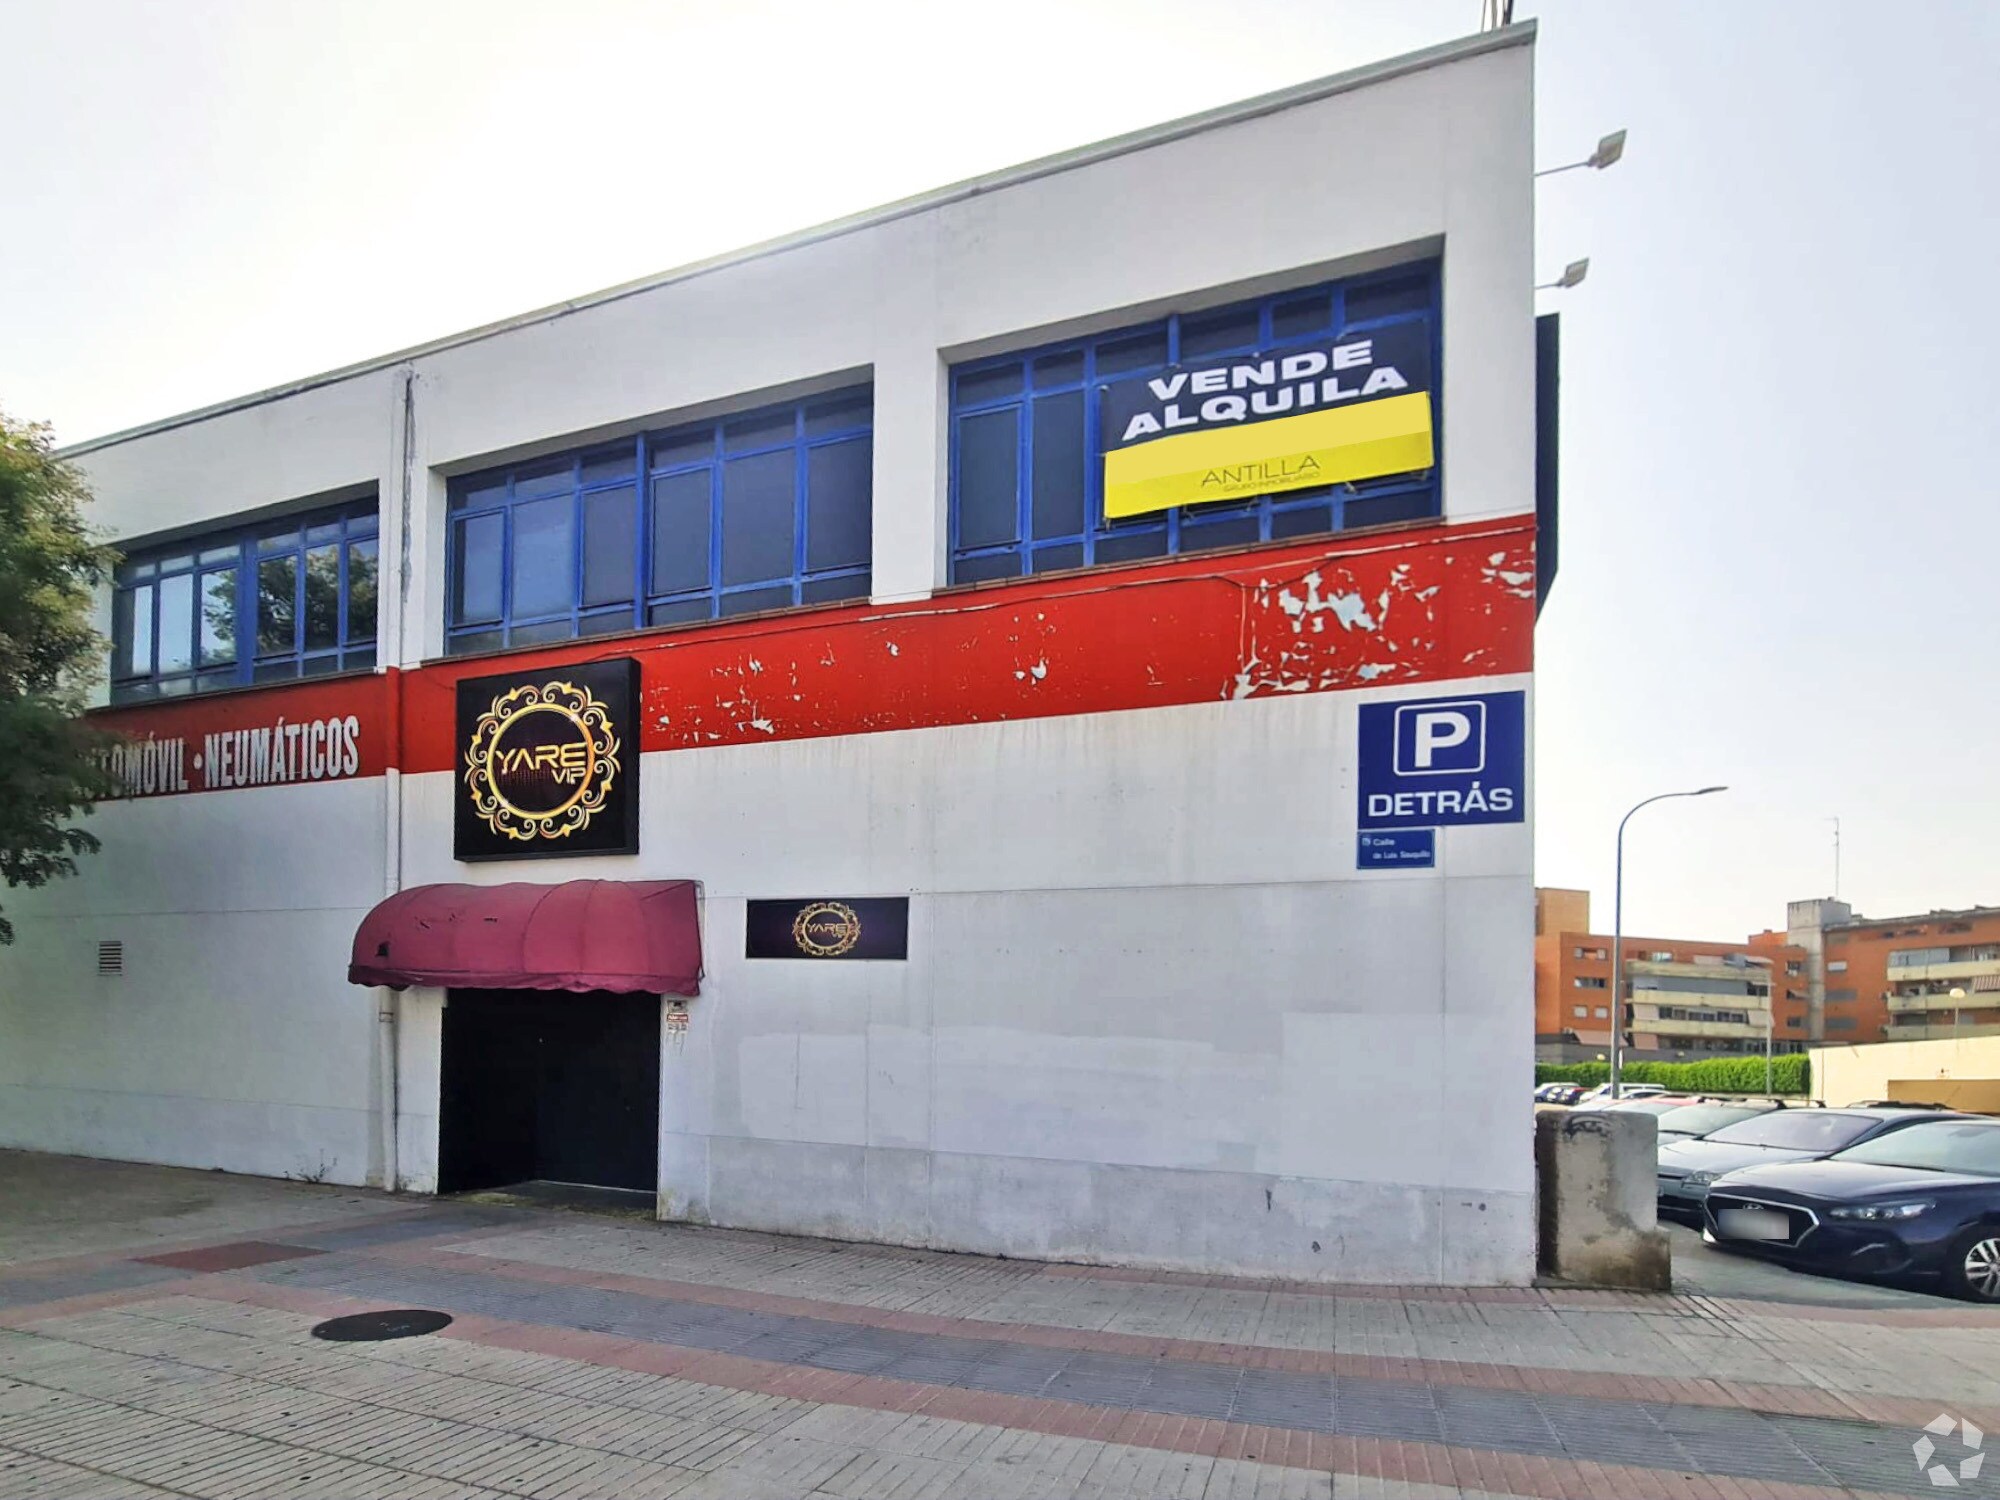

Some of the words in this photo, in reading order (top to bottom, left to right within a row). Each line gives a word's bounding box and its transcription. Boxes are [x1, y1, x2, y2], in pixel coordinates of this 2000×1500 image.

[1149, 340, 1373, 401] VENDE
[1121, 366, 1408, 441] ALQUILA
[1201, 455, 1321, 487] ANTILLA
[1415, 711, 1471, 768] P
[495, 742, 587, 774] YARE
[551, 768, 586, 785] VIP
[1368, 781, 1514, 817] DETRÁS
[807, 923, 848, 935] YARE
